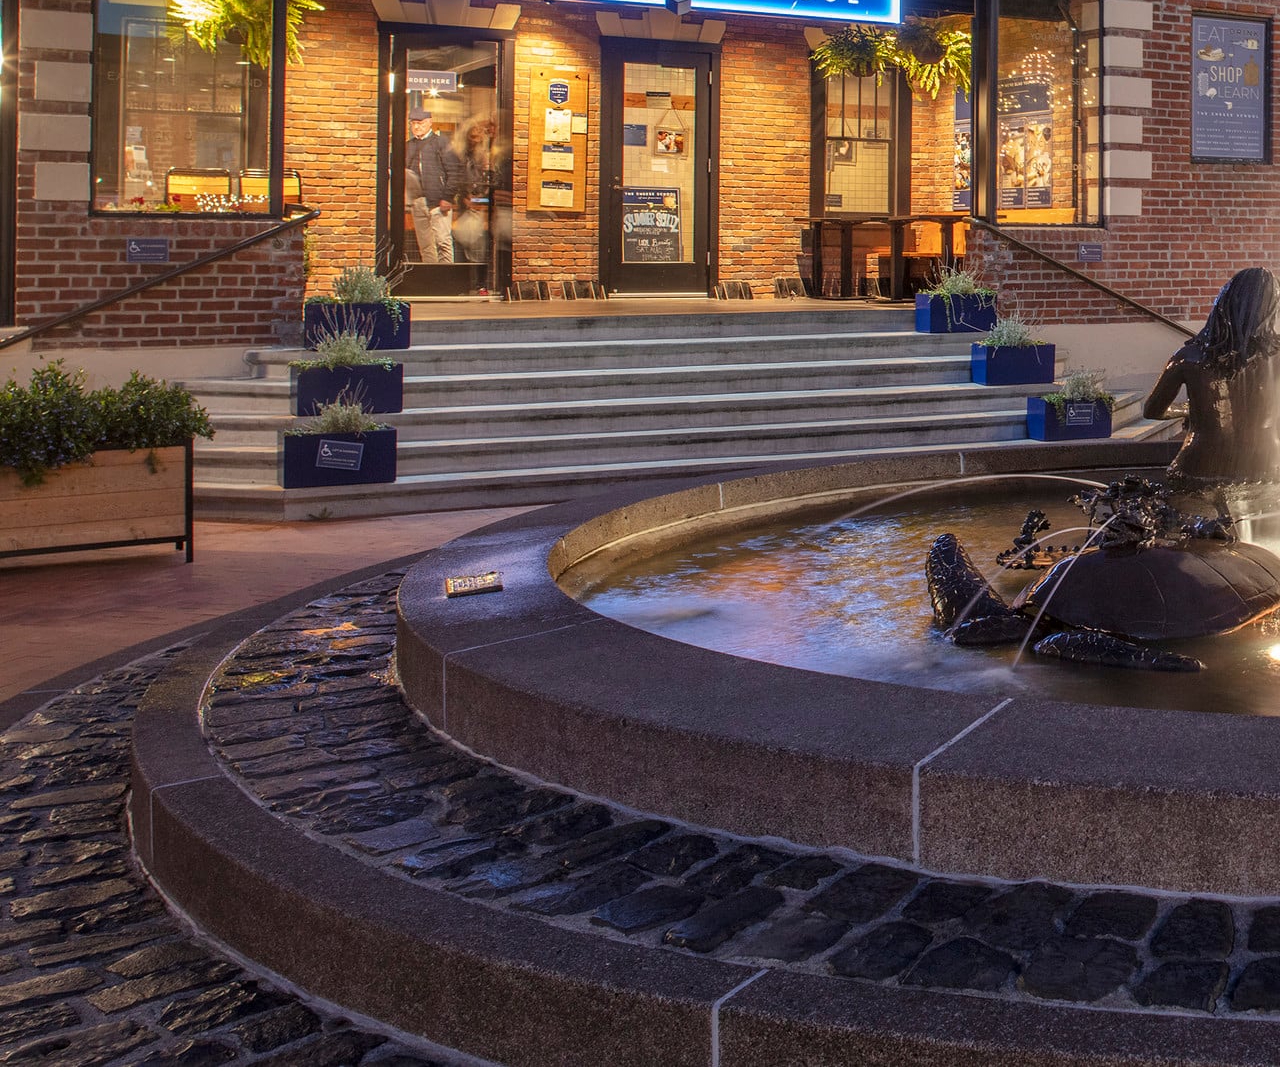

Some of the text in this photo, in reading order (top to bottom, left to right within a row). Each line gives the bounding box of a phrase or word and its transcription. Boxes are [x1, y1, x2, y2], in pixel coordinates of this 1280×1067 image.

[1197, 24, 1259, 43] EAT DRINK
[1210, 65, 1243, 84] SHOP
[1217, 85, 1260, 100] LEARN
